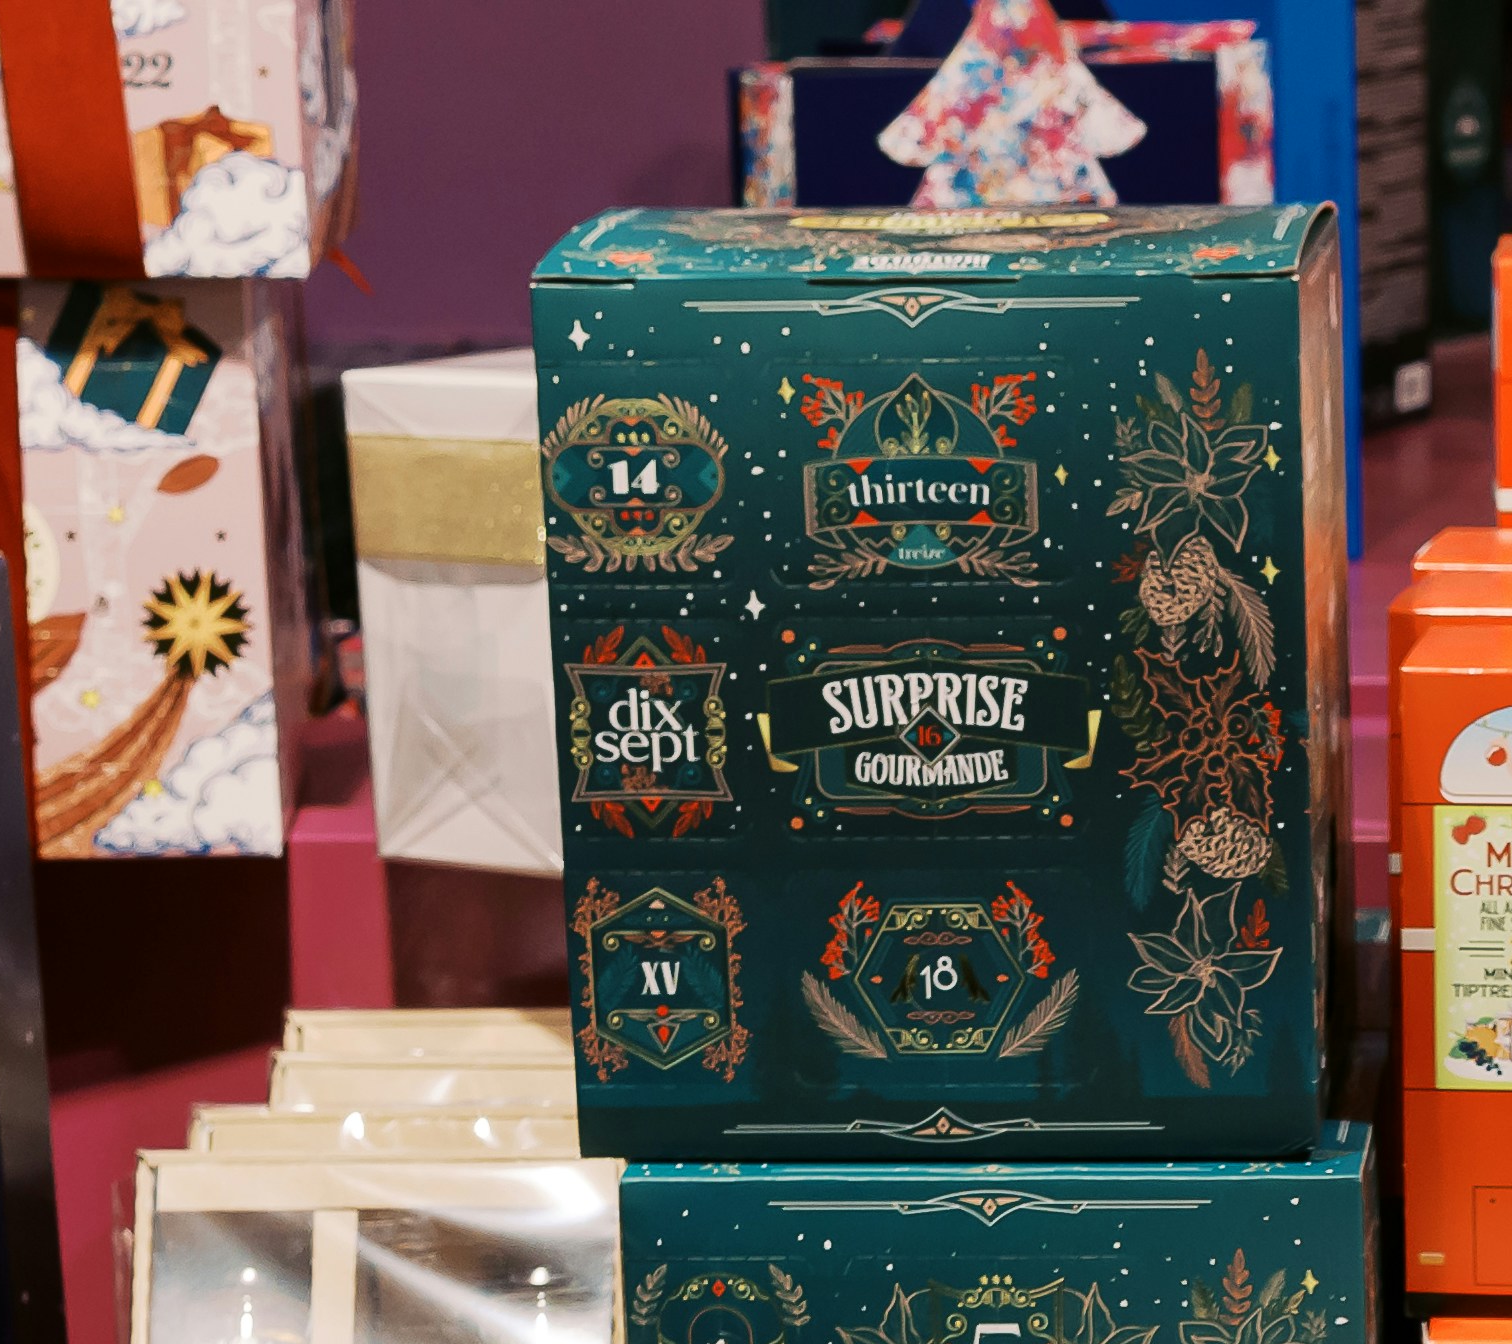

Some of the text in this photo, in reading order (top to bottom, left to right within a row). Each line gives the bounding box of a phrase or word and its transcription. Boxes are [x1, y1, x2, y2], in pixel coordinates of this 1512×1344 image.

[608, 459, 660, 494] 14
[847, 474, 991, 507] thirteen
[608, 688, 682, 732] dix
[821, 672, 1028, 734] SURPRISE
[595, 723, 699, 773] sept
[917, 724, 942, 747] 16
[854, 750, 1009, 788] GOURMANDE
[641, 961, 681, 998] XV
[919, 955, 959, 998] 18
